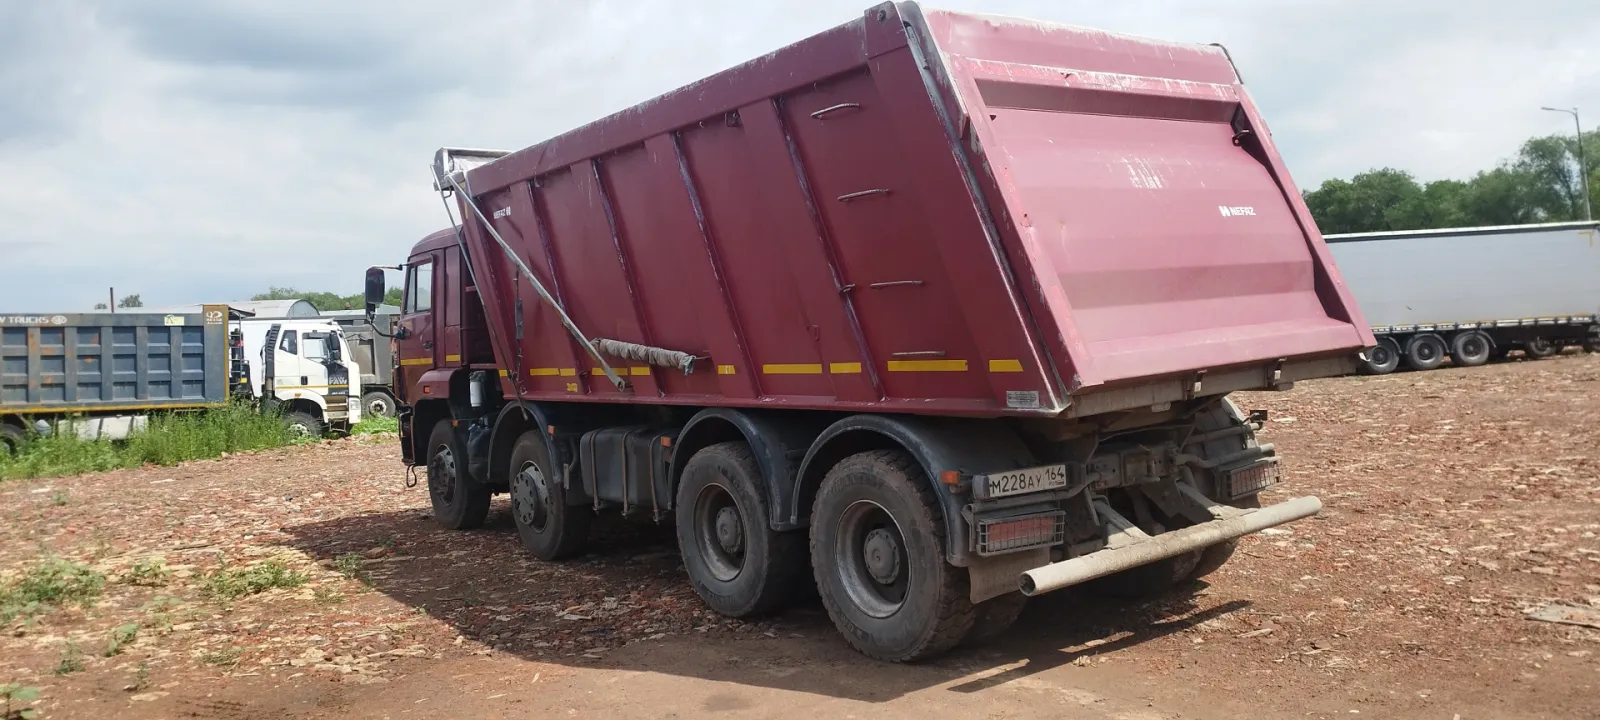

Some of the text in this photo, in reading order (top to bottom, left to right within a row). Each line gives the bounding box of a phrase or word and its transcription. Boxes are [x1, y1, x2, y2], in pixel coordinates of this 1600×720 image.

[1229, 206, 1256, 216] NEFAZ
[8, 316, 49, 324] TRUCKS
[328, 376, 348, 385] FAW
[1045, 467, 1064, 481] 164
